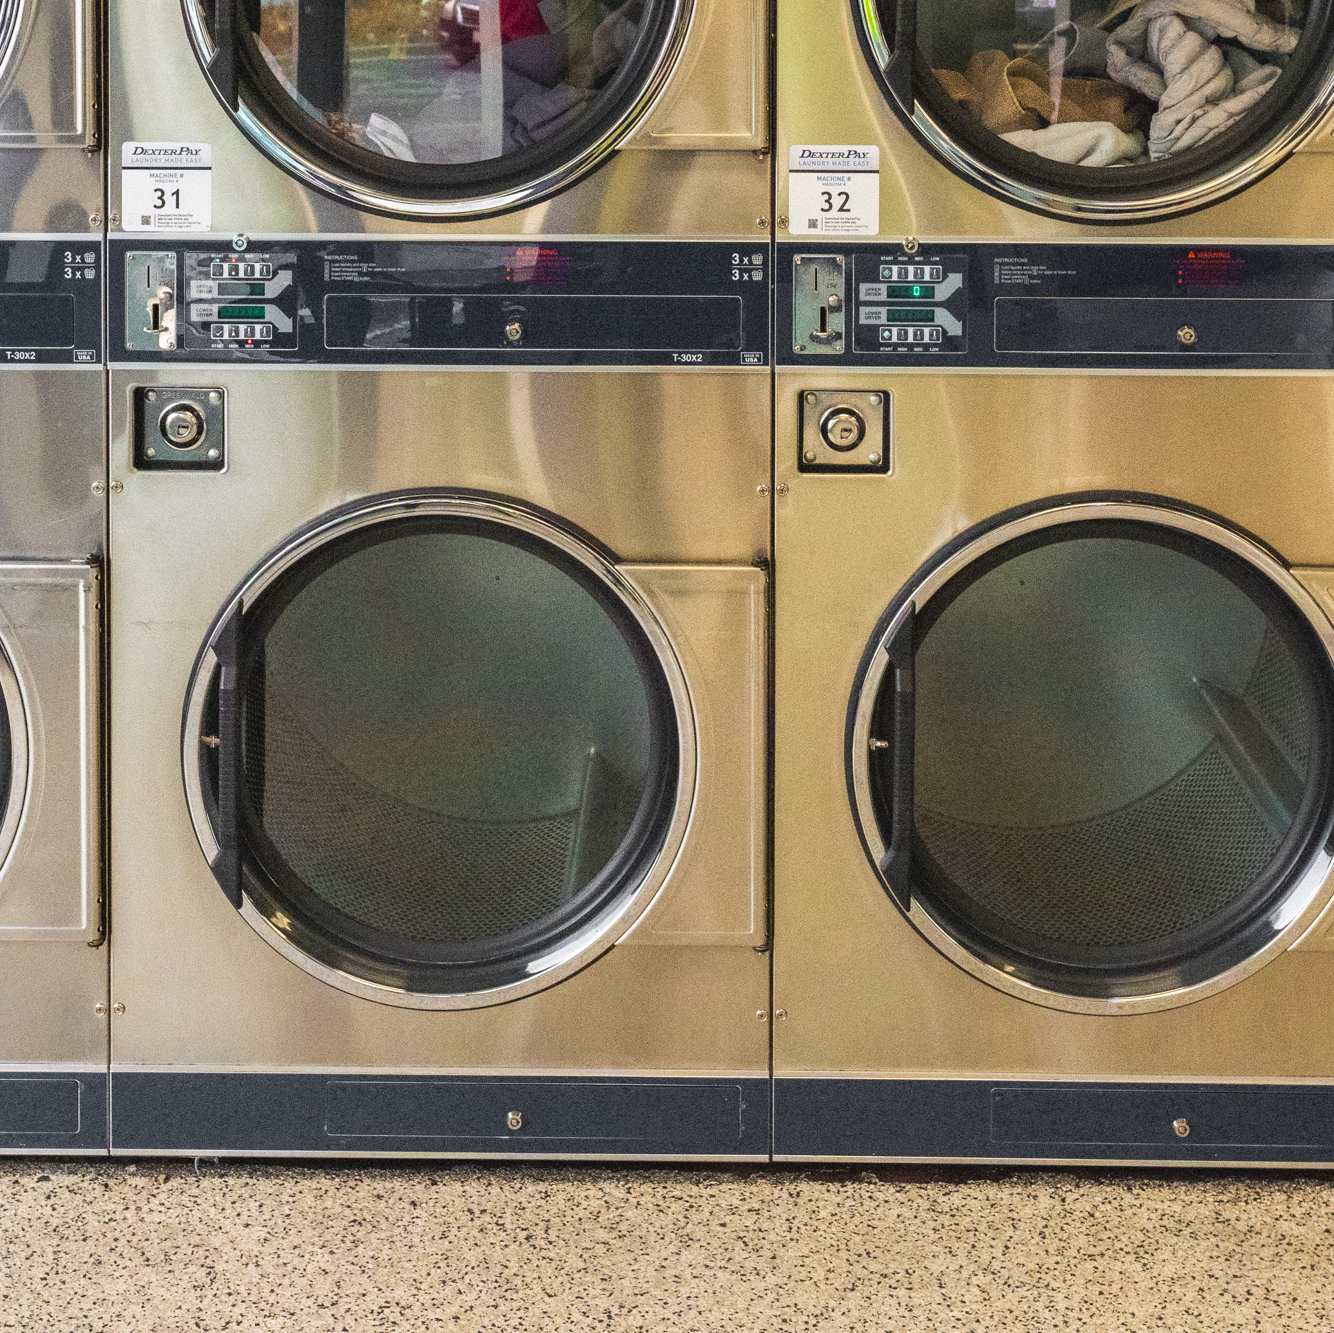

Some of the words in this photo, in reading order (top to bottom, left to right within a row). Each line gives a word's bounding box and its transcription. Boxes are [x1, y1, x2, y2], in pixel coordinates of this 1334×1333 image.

[153, 186, 181, 210] 31
[820, 190, 851, 214] 32
[5, 350, 35, 361] T-30X2
[672, 352, 702, 363] T-30X2
